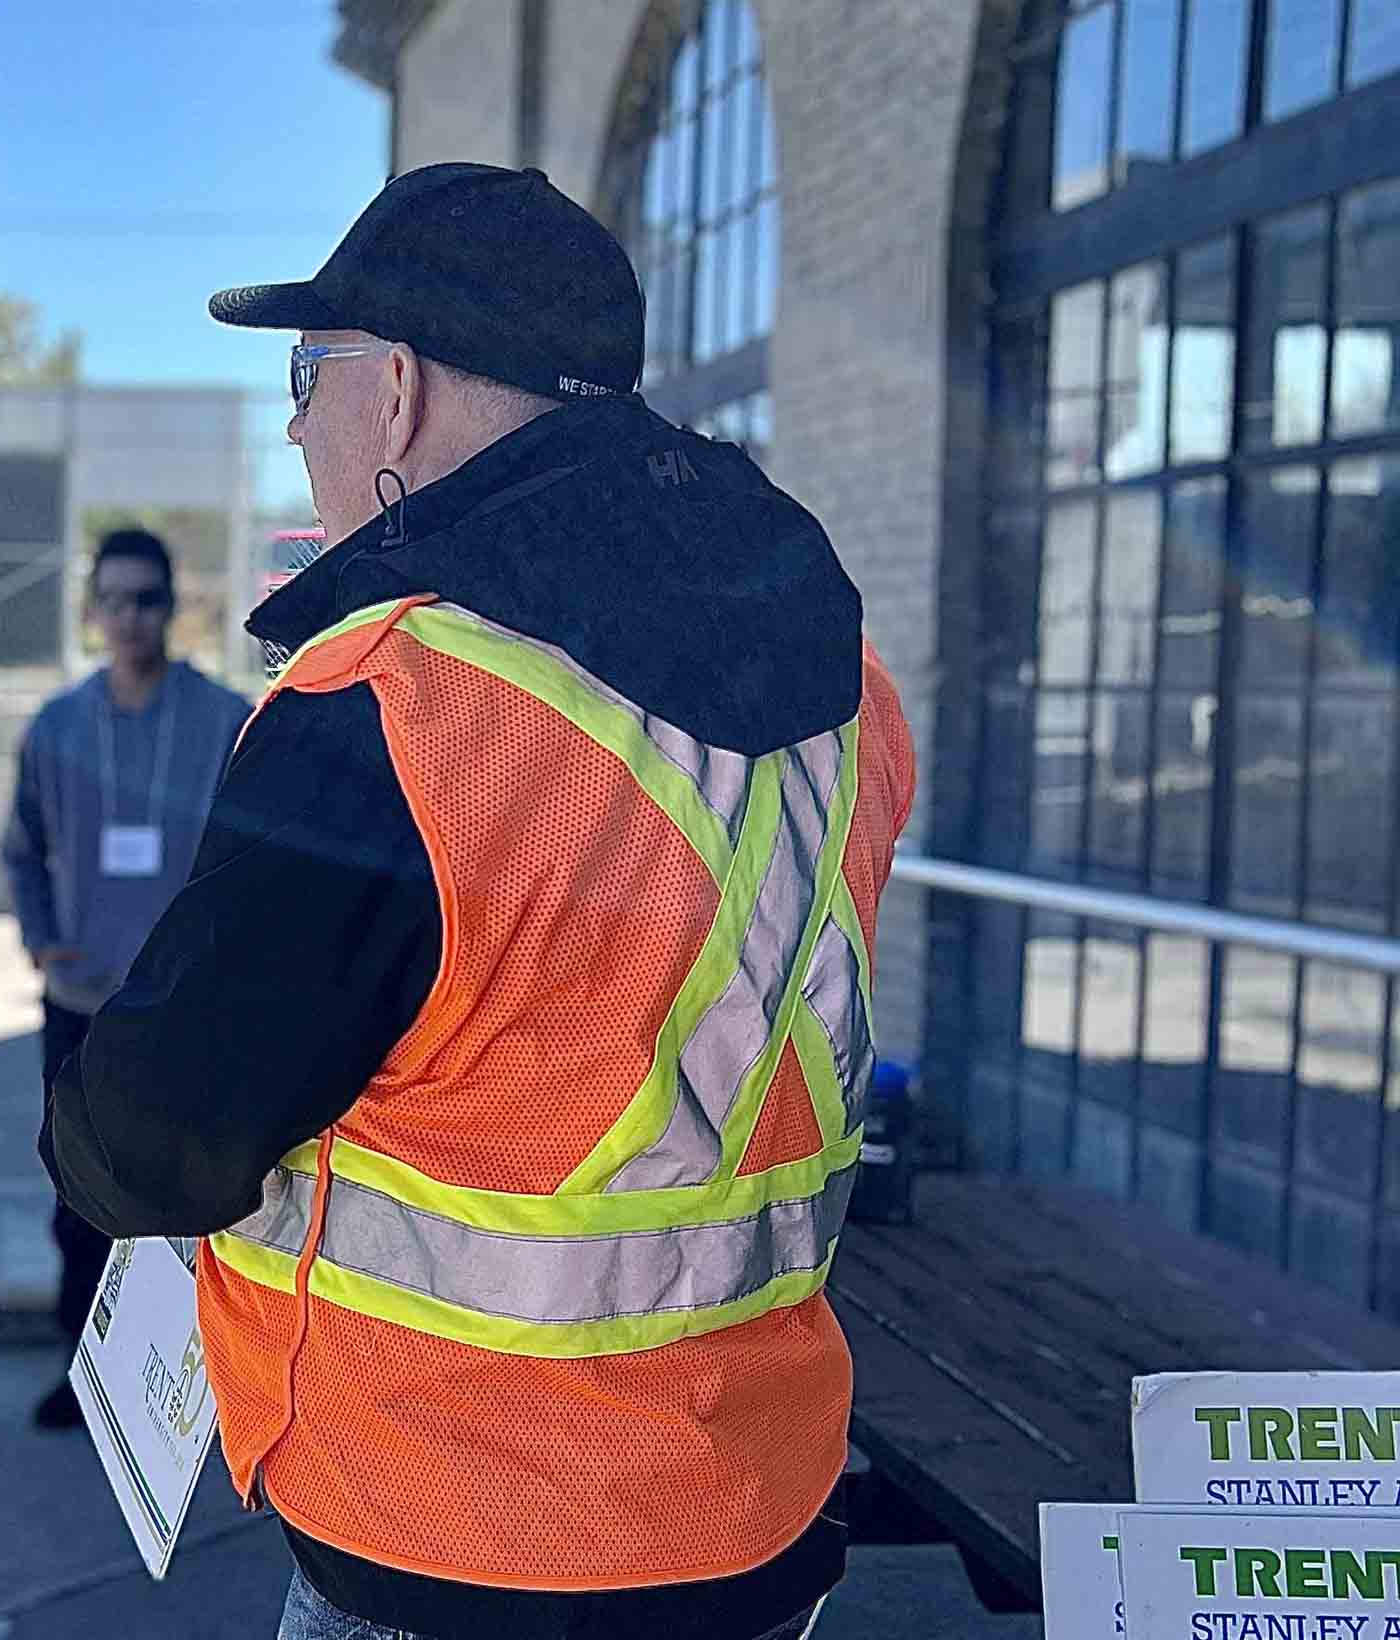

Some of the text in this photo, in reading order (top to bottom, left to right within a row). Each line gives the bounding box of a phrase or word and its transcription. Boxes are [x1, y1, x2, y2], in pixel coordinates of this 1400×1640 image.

[1194, 1406, 1400, 1461] TREN
[1206, 1479, 1381, 1505] STANLEY
[1191, 1612, 1369, 1640] STANLEY
